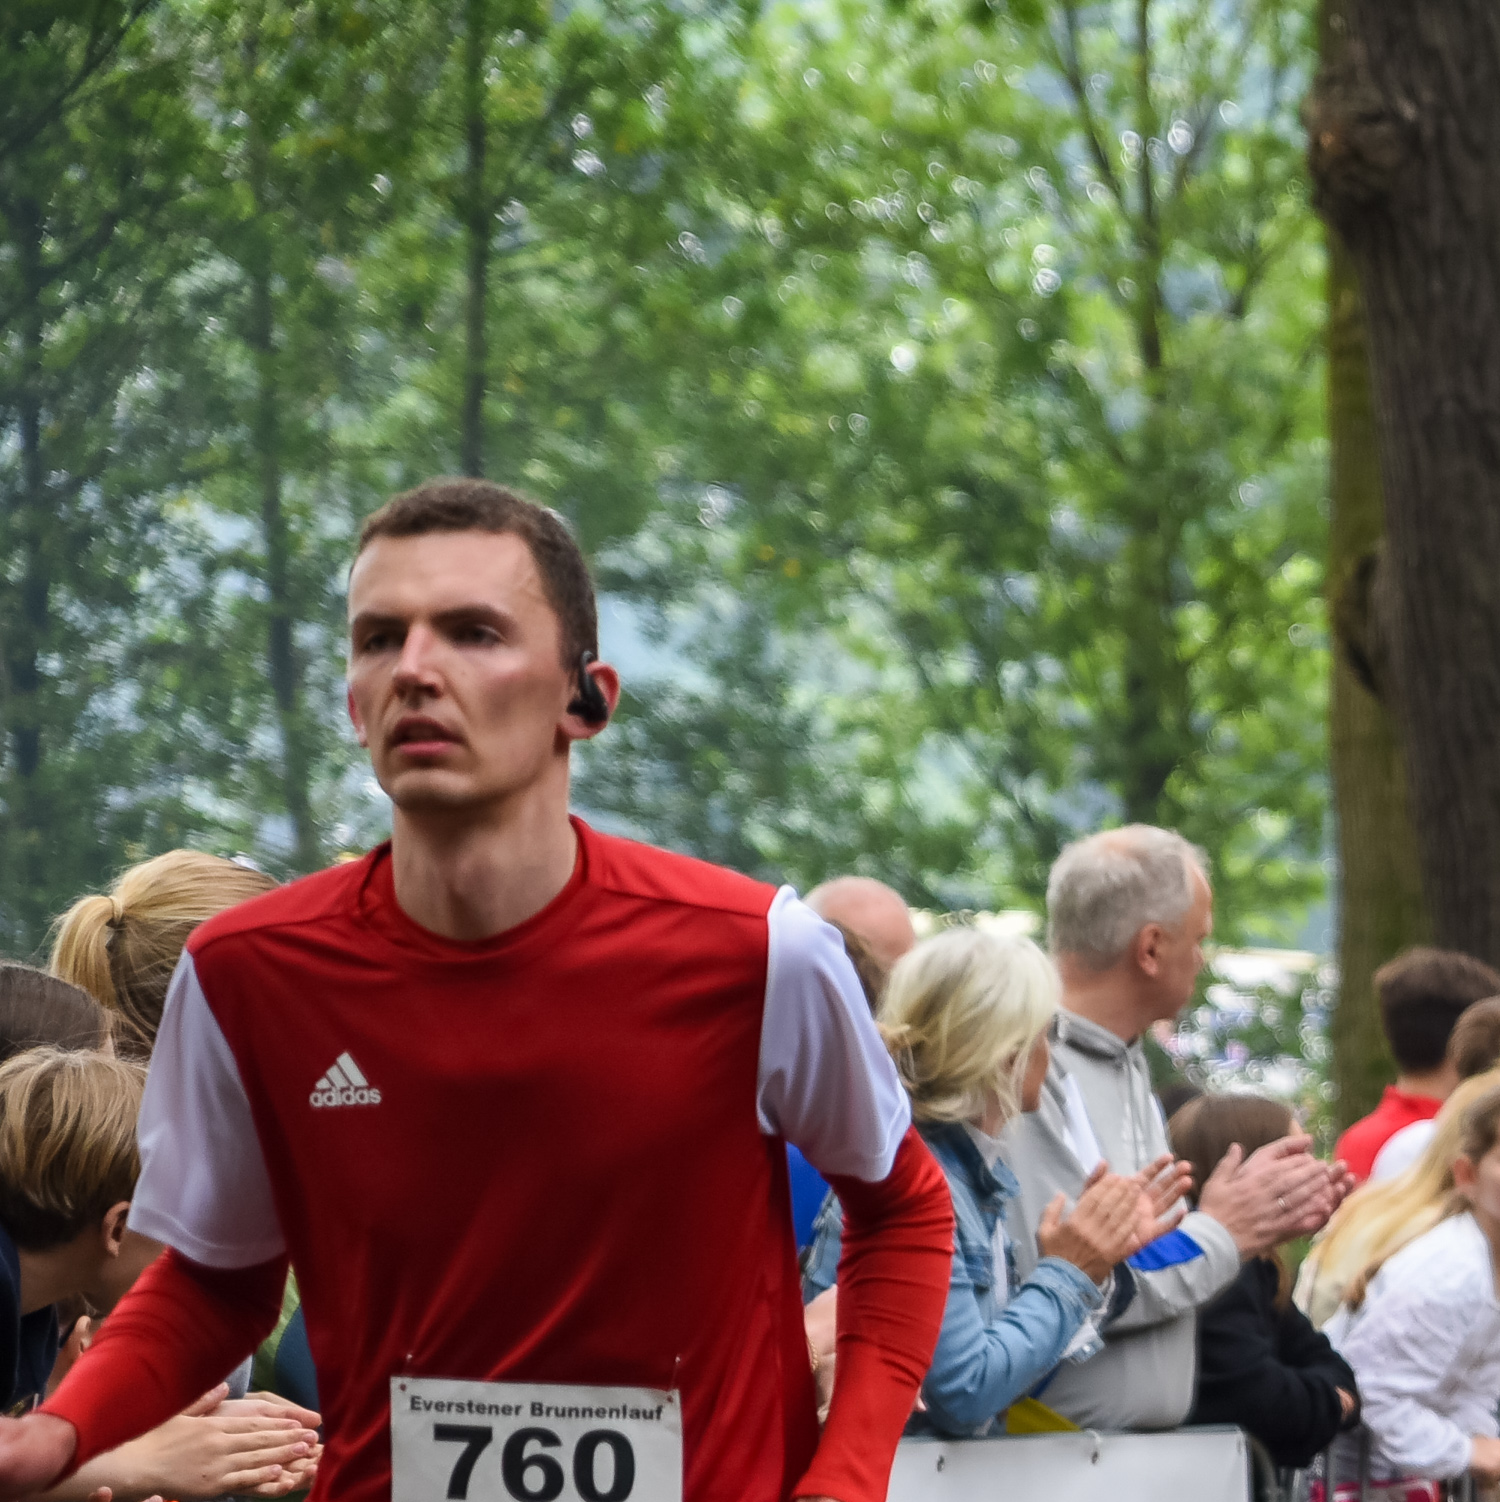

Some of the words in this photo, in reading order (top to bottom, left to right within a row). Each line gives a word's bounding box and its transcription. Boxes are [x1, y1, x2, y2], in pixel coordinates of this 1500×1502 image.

[309, 1084, 382, 1107] adidas
[409, 1395, 522, 1416] Everstener
[530, 1401, 663, 1421] Brunnenlauf
